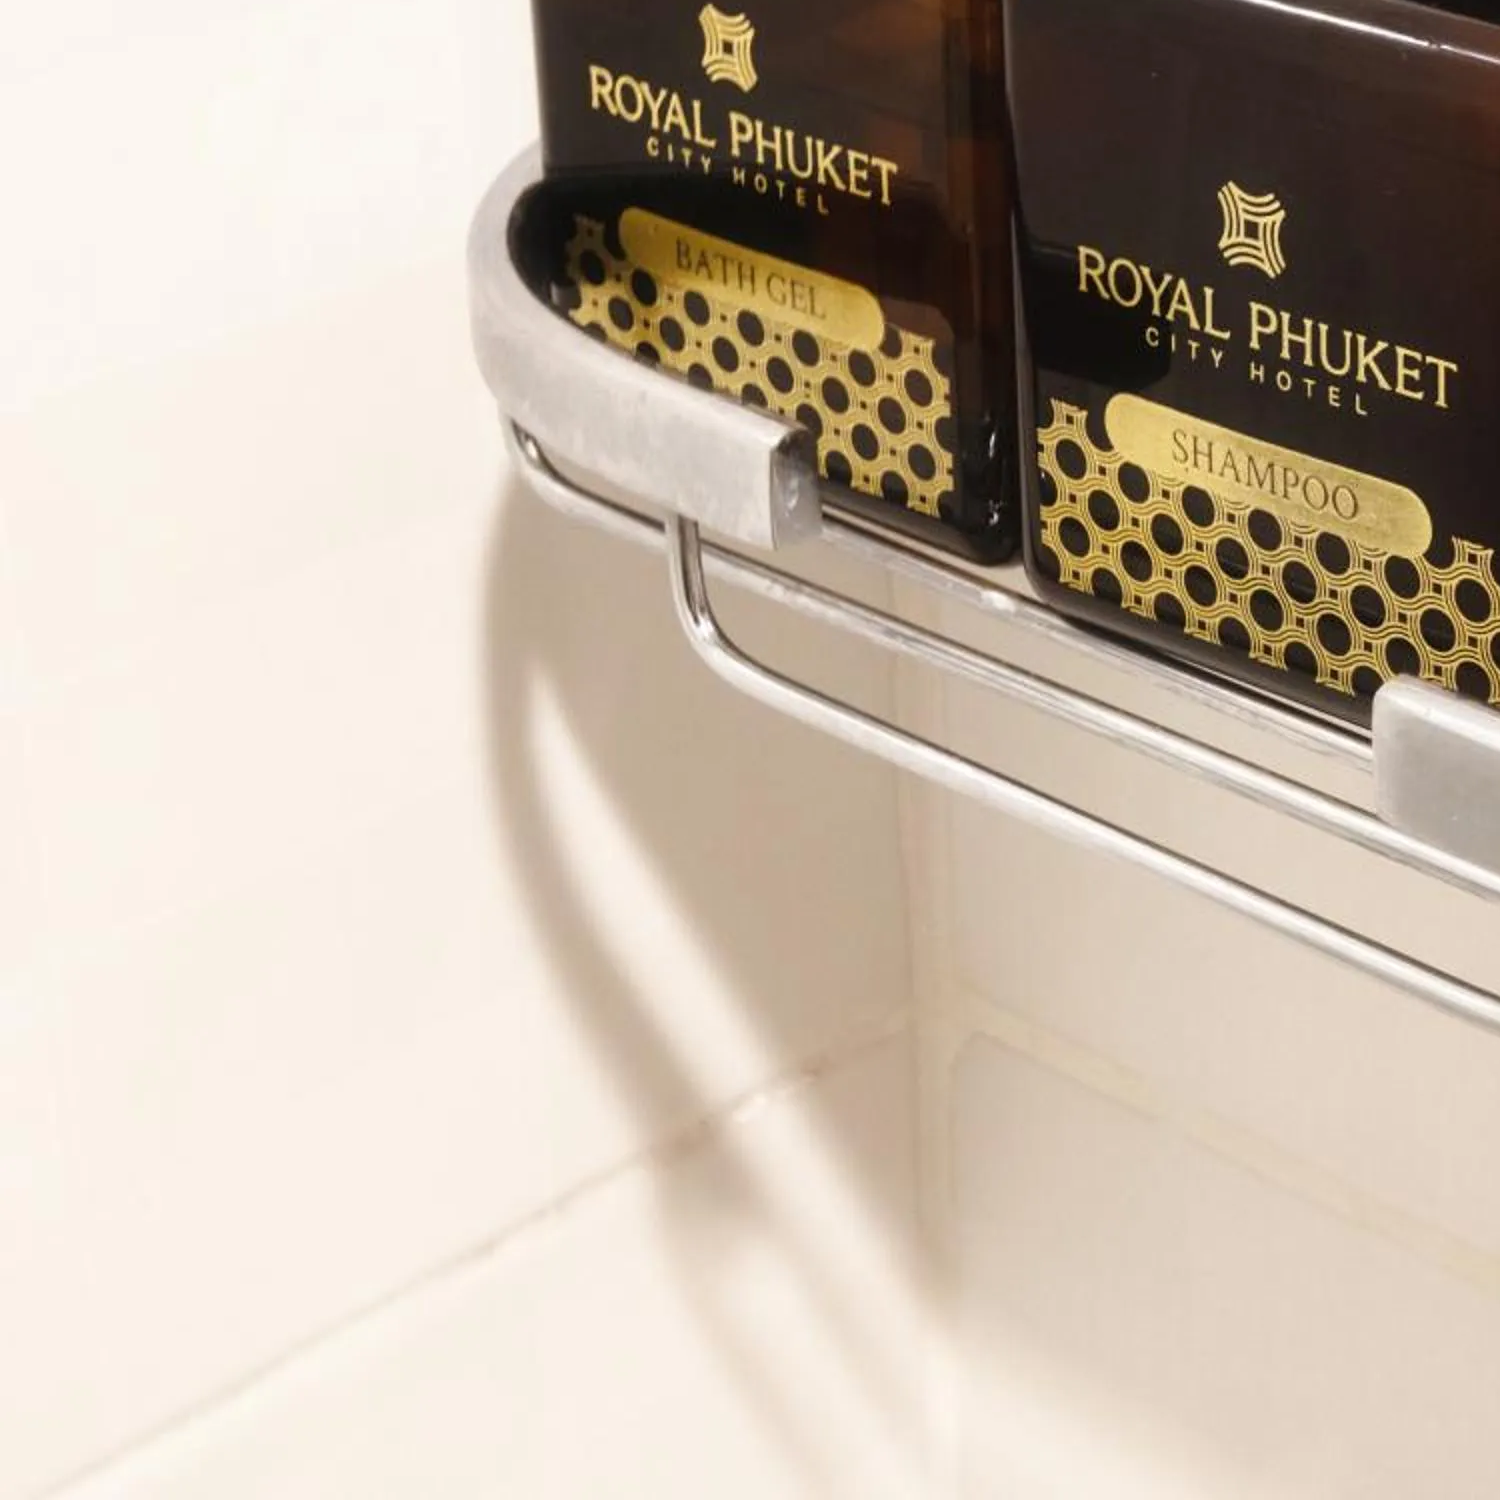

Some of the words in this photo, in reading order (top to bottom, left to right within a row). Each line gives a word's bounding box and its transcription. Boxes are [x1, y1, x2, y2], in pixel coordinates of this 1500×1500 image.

[589, 66, 716, 149] ROYAL
[729, 112, 898, 206] PHUKET
[648, 136, 713, 173] CITY
[734, 169, 829, 215] HOTEL
[676, 238, 756, 295] BATH
[767, 273, 827, 320] GEL
[1077, 246, 1231, 339] ROYAL
[1248, 301, 1458, 409] PHUKET
[1146, 327, 1223, 368] CITY
[1251, 363, 1367, 415] HOTEL
[1171, 429, 1359, 521] SHAMPOO
